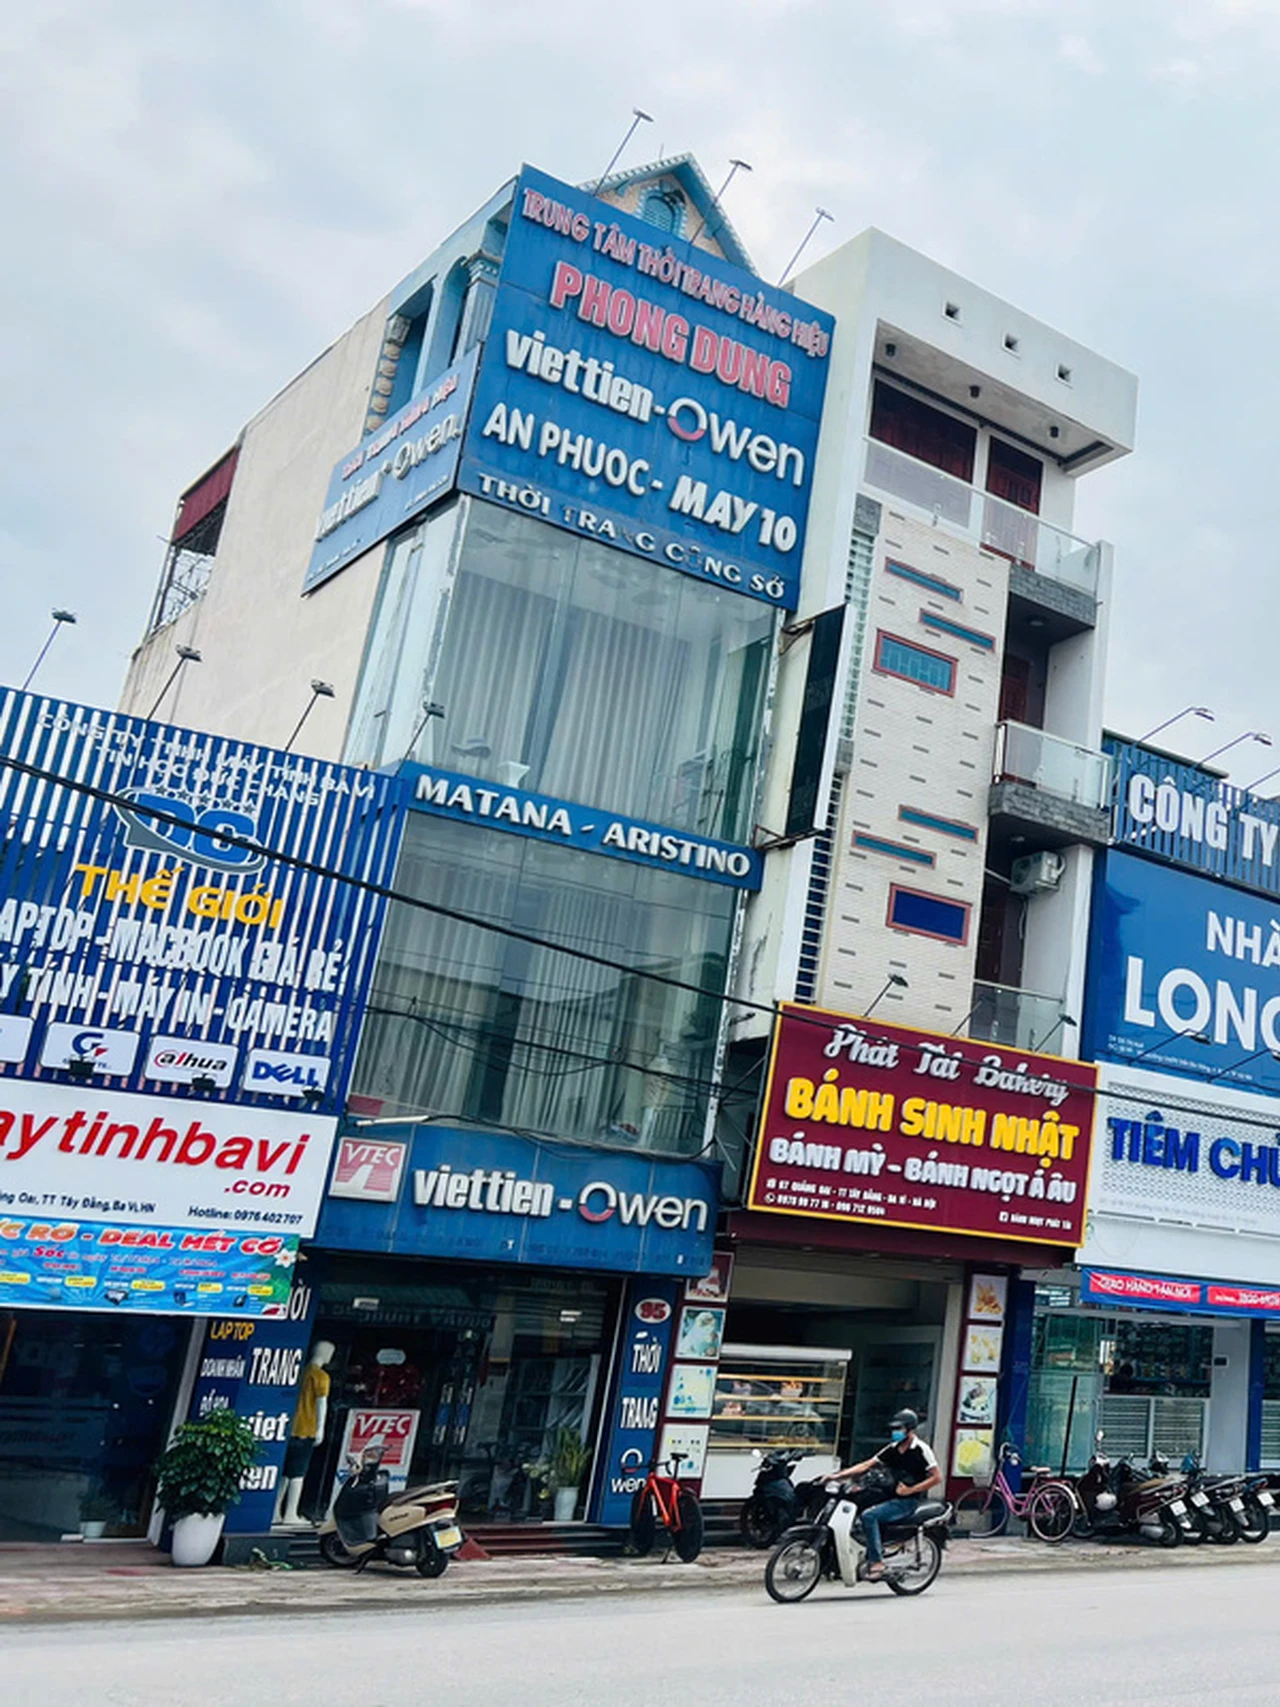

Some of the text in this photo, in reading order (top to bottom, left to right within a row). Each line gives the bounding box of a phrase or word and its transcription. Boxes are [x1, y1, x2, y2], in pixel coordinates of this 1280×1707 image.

[521, 187, 590, 242] TRUNG
[593, 223, 636, 268] TÂM
[549, 261, 792, 408] PHONG DUNG
[482, 403, 536, 450] AN
[668, 475, 756, 534] MAY
[762, 508, 798, 553] 10
[477, 471, 552, 518] THỜI
[749, 573, 786, 599] SỞ
[415, 774, 572, 835] MATANA
[603, 822, 750, 878] ARISTINO
[1128, 774, 1229, 851] CÔNG
[1239, 812, 1280, 867] TY
[75, 864, 282, 929] THẾ GIỚI
[252, 1061, 320, 1086] DELL
[786, 1067, 1079, 1168] BÁNH SINH NHẬT
[1108, 1110, 1200, 1173] TIÊM
[343, 1143, 400, 1167] VTEC
[769, 1132, 841, 1171] BÁNH
[904, 1150, 968, 1190] BÁNH
[971, 1166, 1031, 1203] NGỌT
[1047, 1172, 1077, 1204] ÂU
[224, 1178, 291, 1199] .com
[413, 1164, 554, 1218] viettien
[577, 1181, 709, 1231] Owen
[100, 1229, 174, 1249] DEAL
[179, 1229, 238, 1252] HẾT
[210, 1321, 255, 1341] LAPTOP
[249, 1347, 302, 1386] TRANG
[357, 1414, 411, 1436] VTEC
